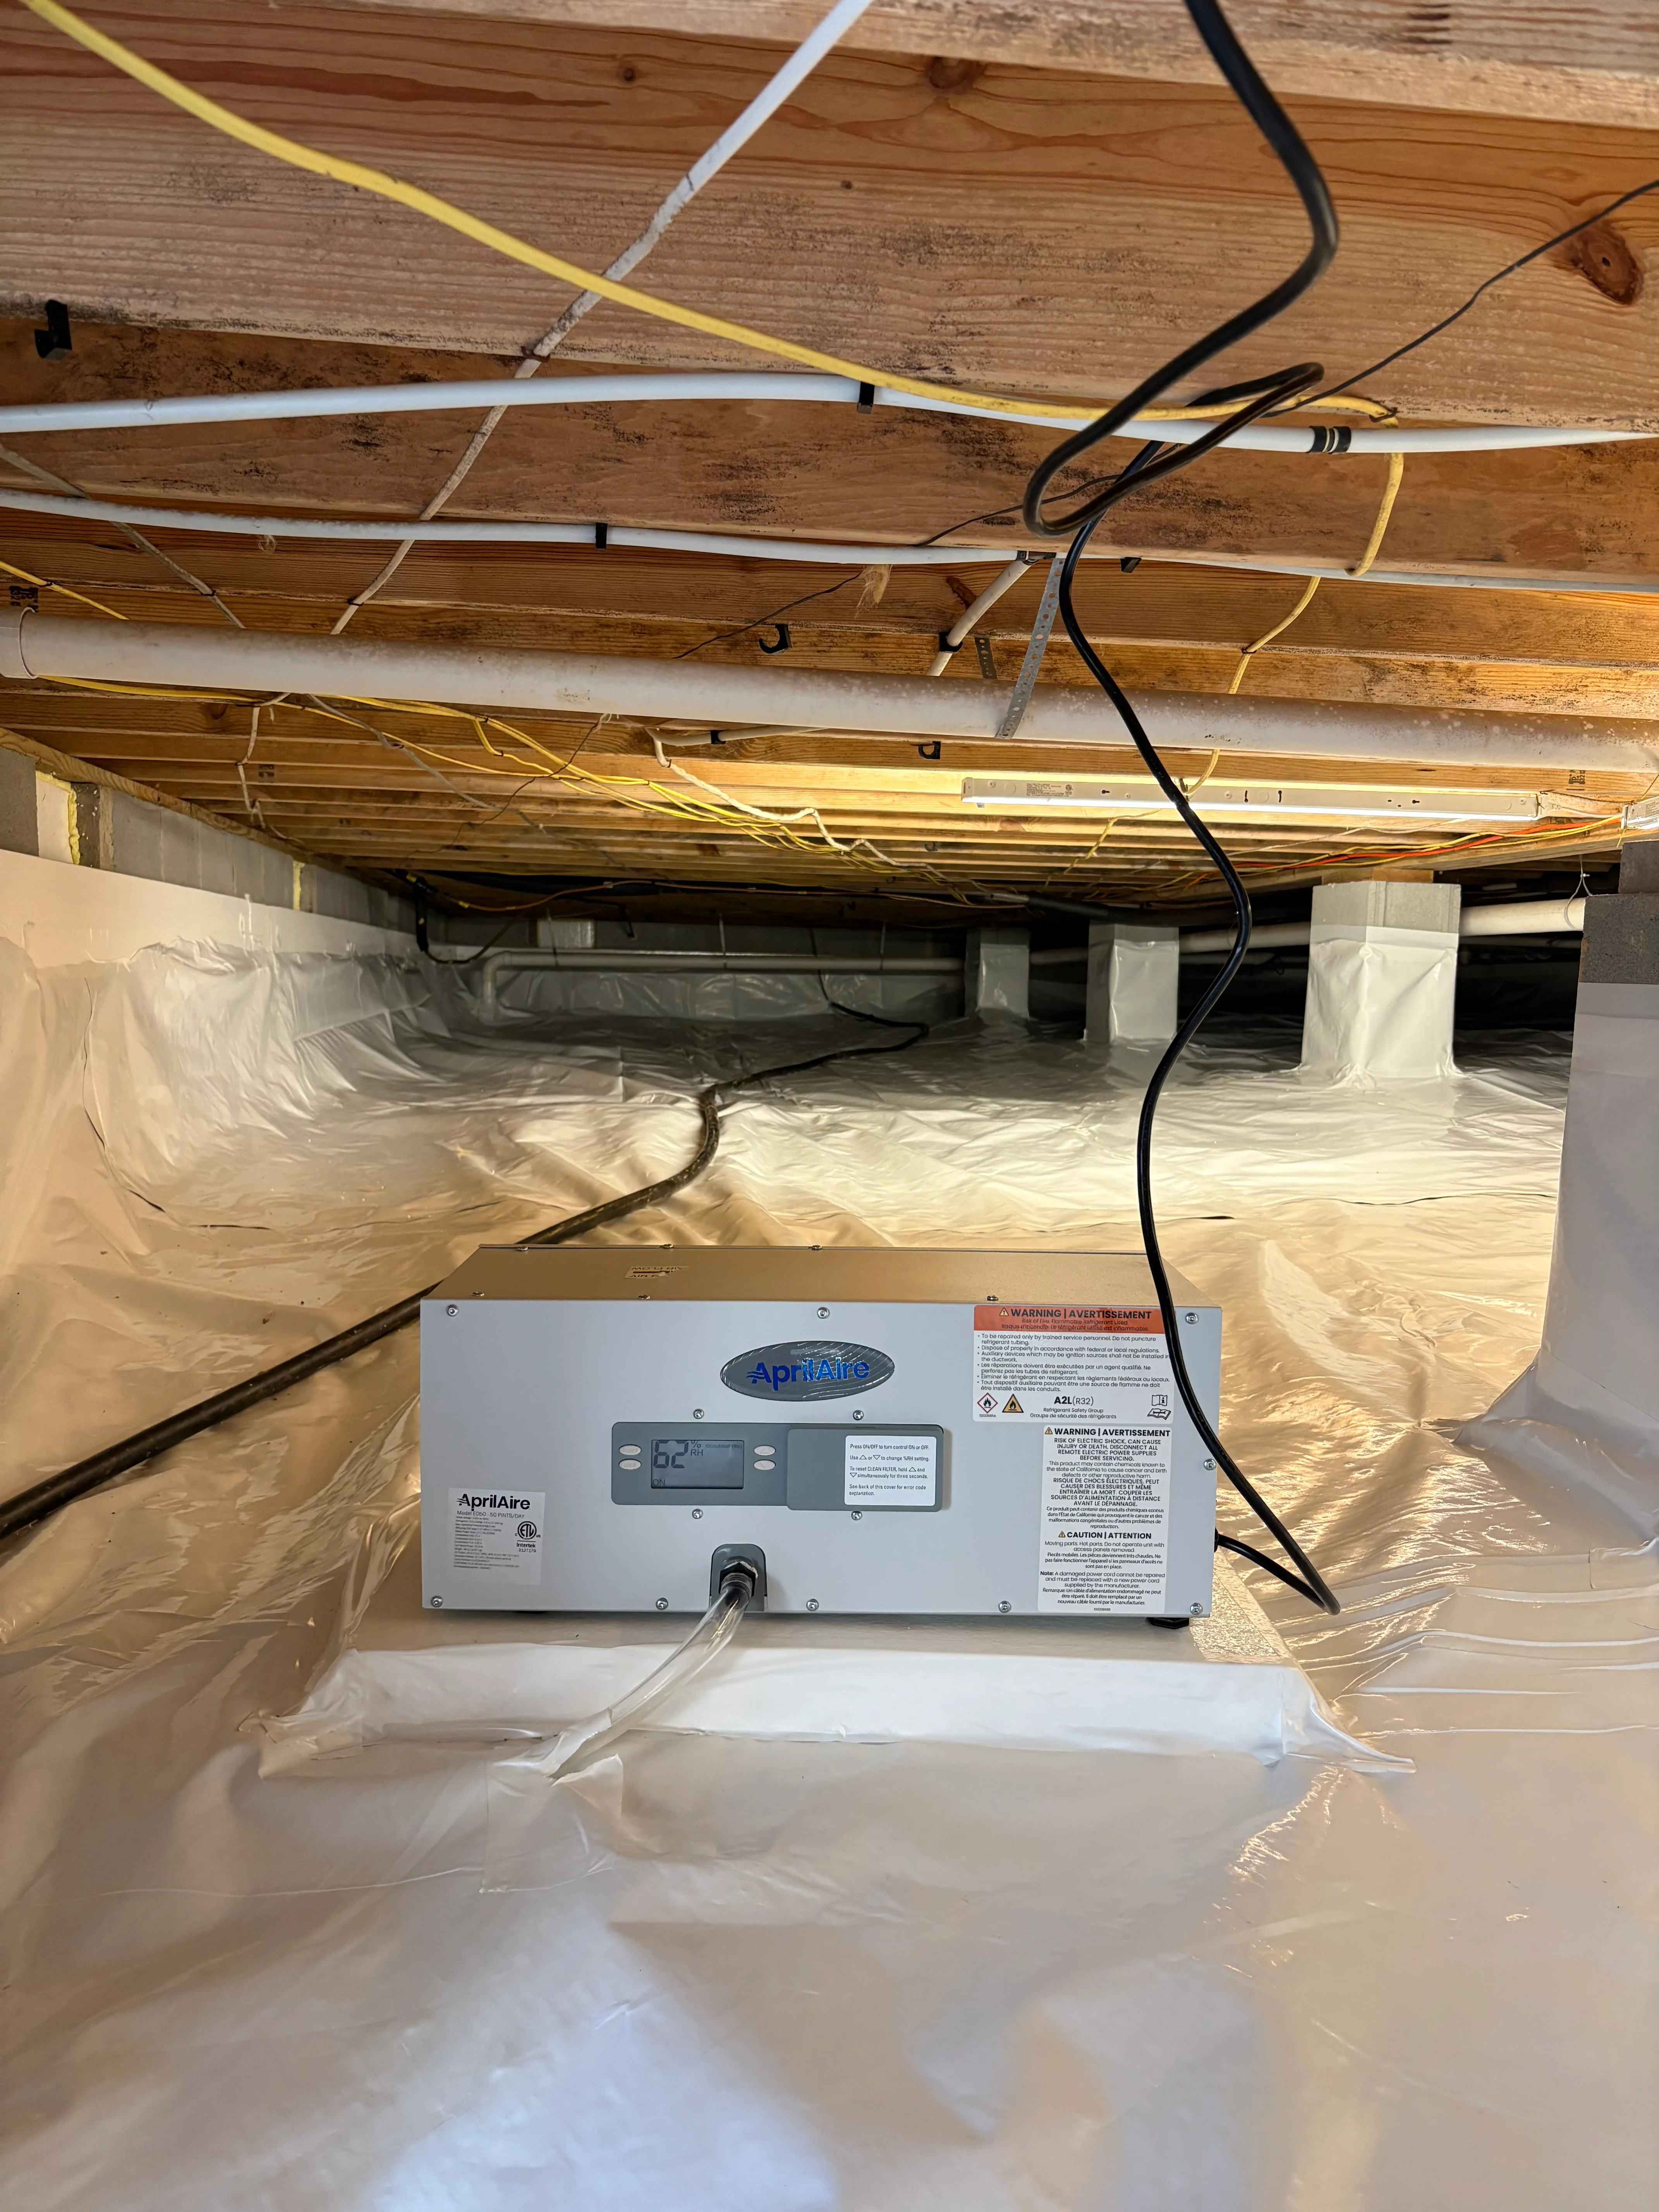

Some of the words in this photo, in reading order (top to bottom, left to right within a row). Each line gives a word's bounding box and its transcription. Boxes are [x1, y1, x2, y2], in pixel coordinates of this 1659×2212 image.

[1011, 1309, 1061, 1317] WARNING
[1069, 1310, 1151, 1319] AVERTISSEMENT
[746, 1357, 869, 1391] AprilAire
[654, 1440, 689, 1468] 62
[456, 1494, 530, 1511] AprilAire
